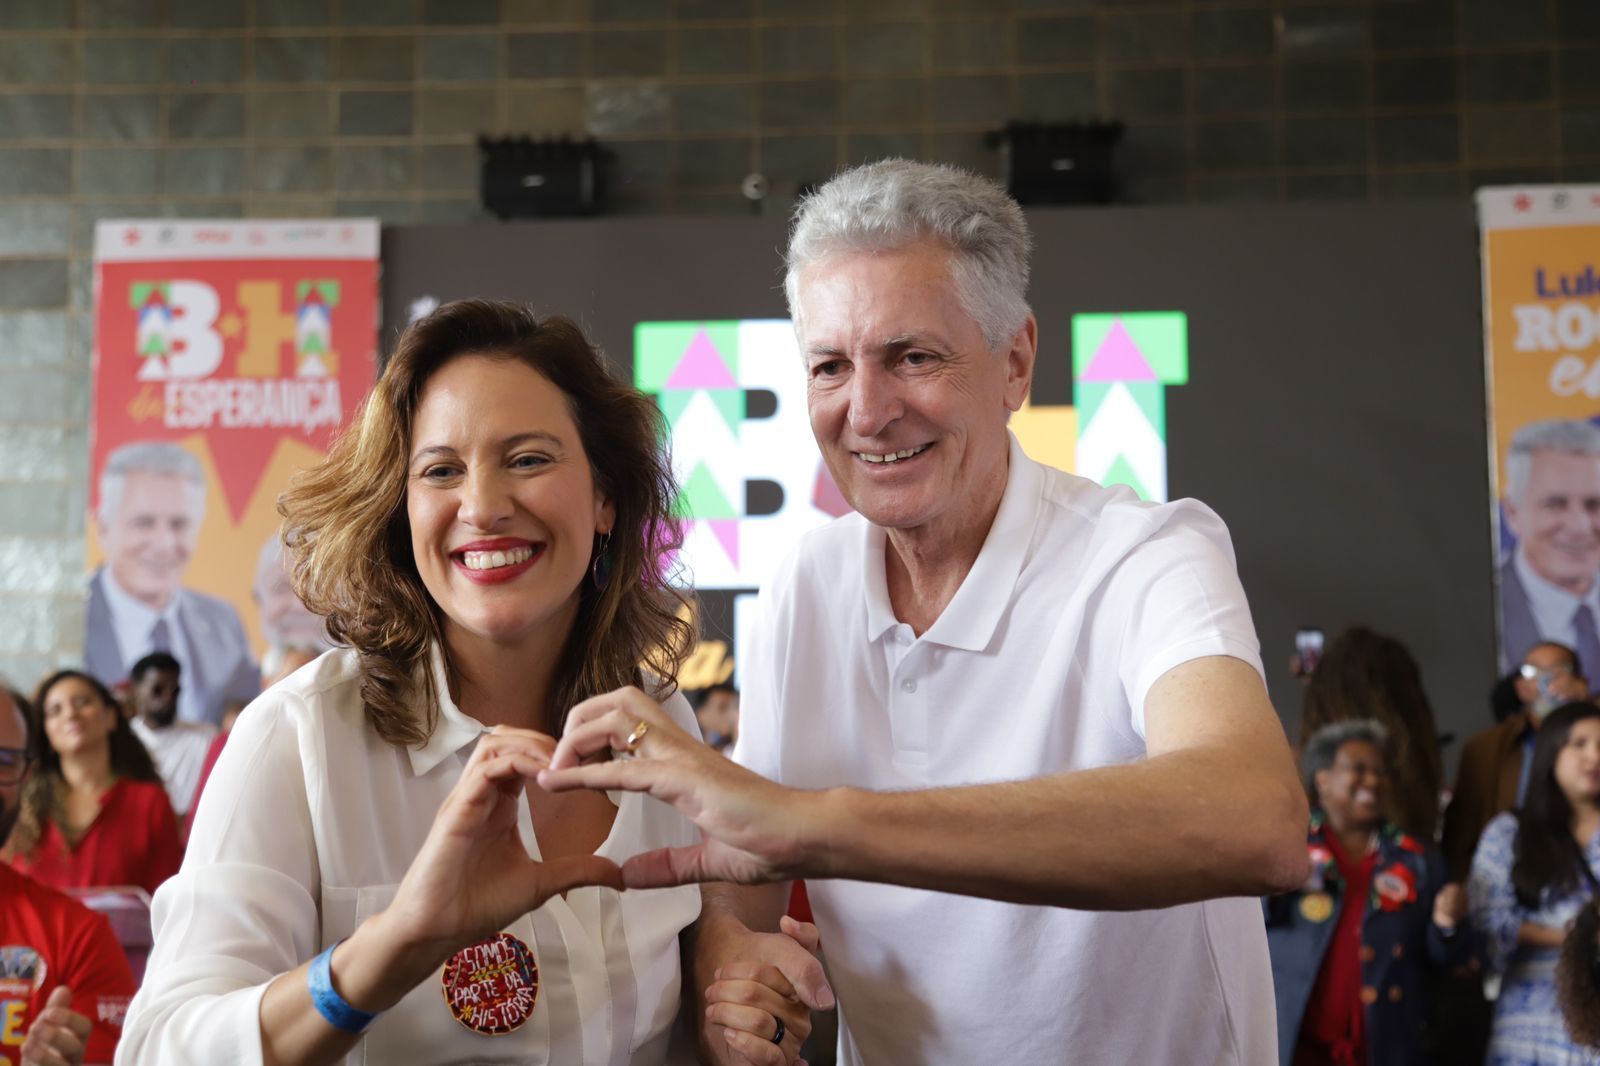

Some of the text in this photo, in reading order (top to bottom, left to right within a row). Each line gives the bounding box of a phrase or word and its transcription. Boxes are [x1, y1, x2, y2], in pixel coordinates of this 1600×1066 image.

[1513, 302, 1600, 352] RO
[164, 379, 342, 434] ESPERANÇA
[463, 937, 516, 975] SOMOS
[454, 970, 525, 1009] PARTE DA
